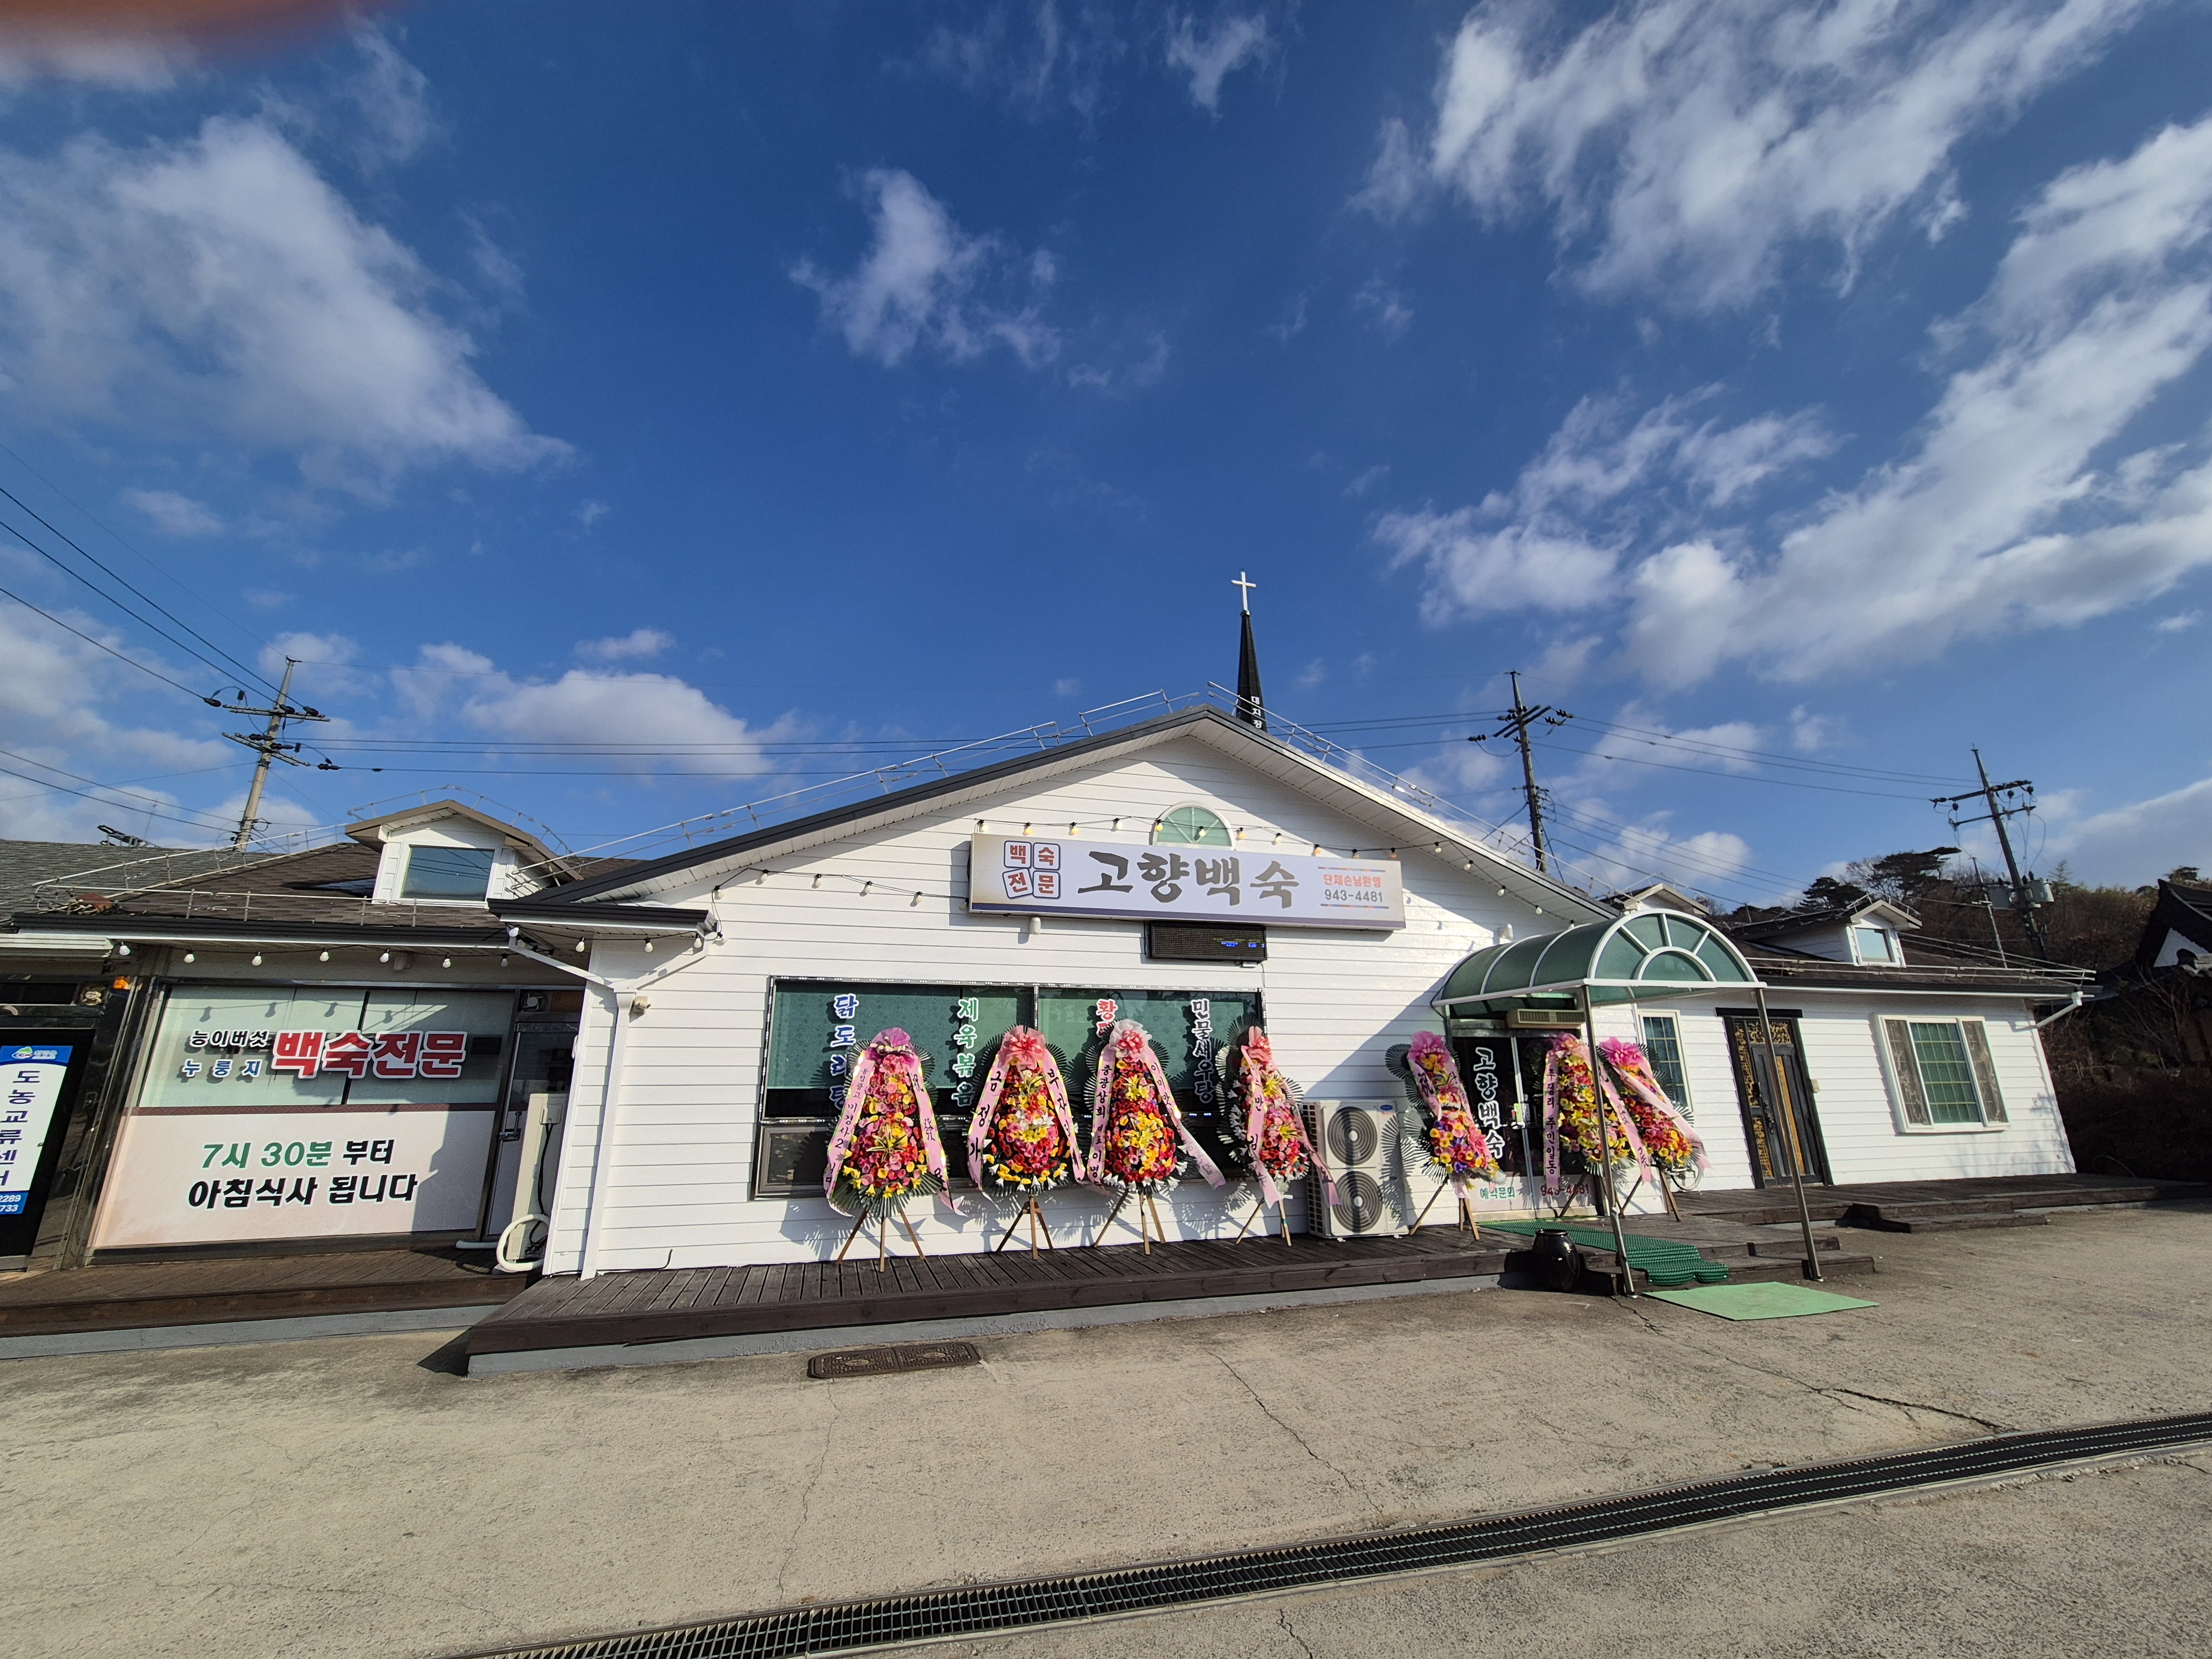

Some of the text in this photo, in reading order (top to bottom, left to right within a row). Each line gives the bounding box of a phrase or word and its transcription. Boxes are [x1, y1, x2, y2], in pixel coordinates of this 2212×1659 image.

[1010, 845, 1055, 866] 백숙
[1008, 872, 1054, 894] 전문
[1077, 851, 1300, 909] 고향백숙
[1323, 874, 1381, 888] 단체손님환영
[1324, 889, 1383, 902] 943-4481
[190, 1030, 269, 1048] 능이버섯
[272, 1030, 468, 1080] 백숙전문
[951, 997, 979, 1107] 제육볶음
[1191, 998, 1217, 1104] 민물새우탕
[183, 1060, 261, 1078] 누룽지
[1474, 1047, 1505, 1159] 고향백숙
[201, 1139, 395, 1170] 7시 30분 부터
[1545, 1117, 1556, 1175] 주민일동
[189, 1173, 419, 1210] 아침식사 됩니다
